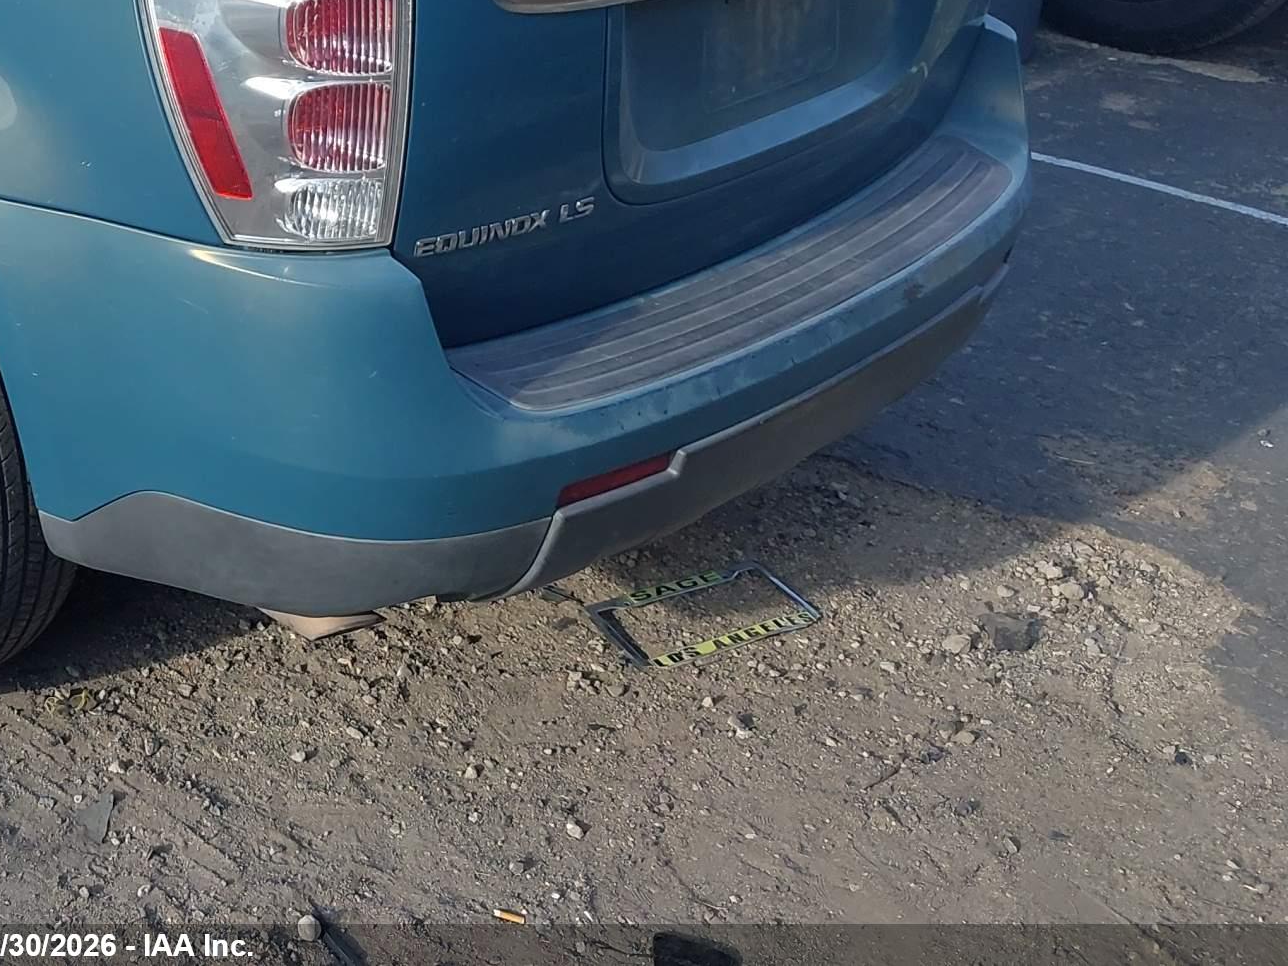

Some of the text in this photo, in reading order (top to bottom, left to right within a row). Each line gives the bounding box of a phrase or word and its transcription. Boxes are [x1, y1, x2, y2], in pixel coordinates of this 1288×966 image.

[413, 196, 596, 258] EQUINOX LS
[630, 570, 721, 602] SAGE
[653, 611, 814, 667] LOS ANGELES
